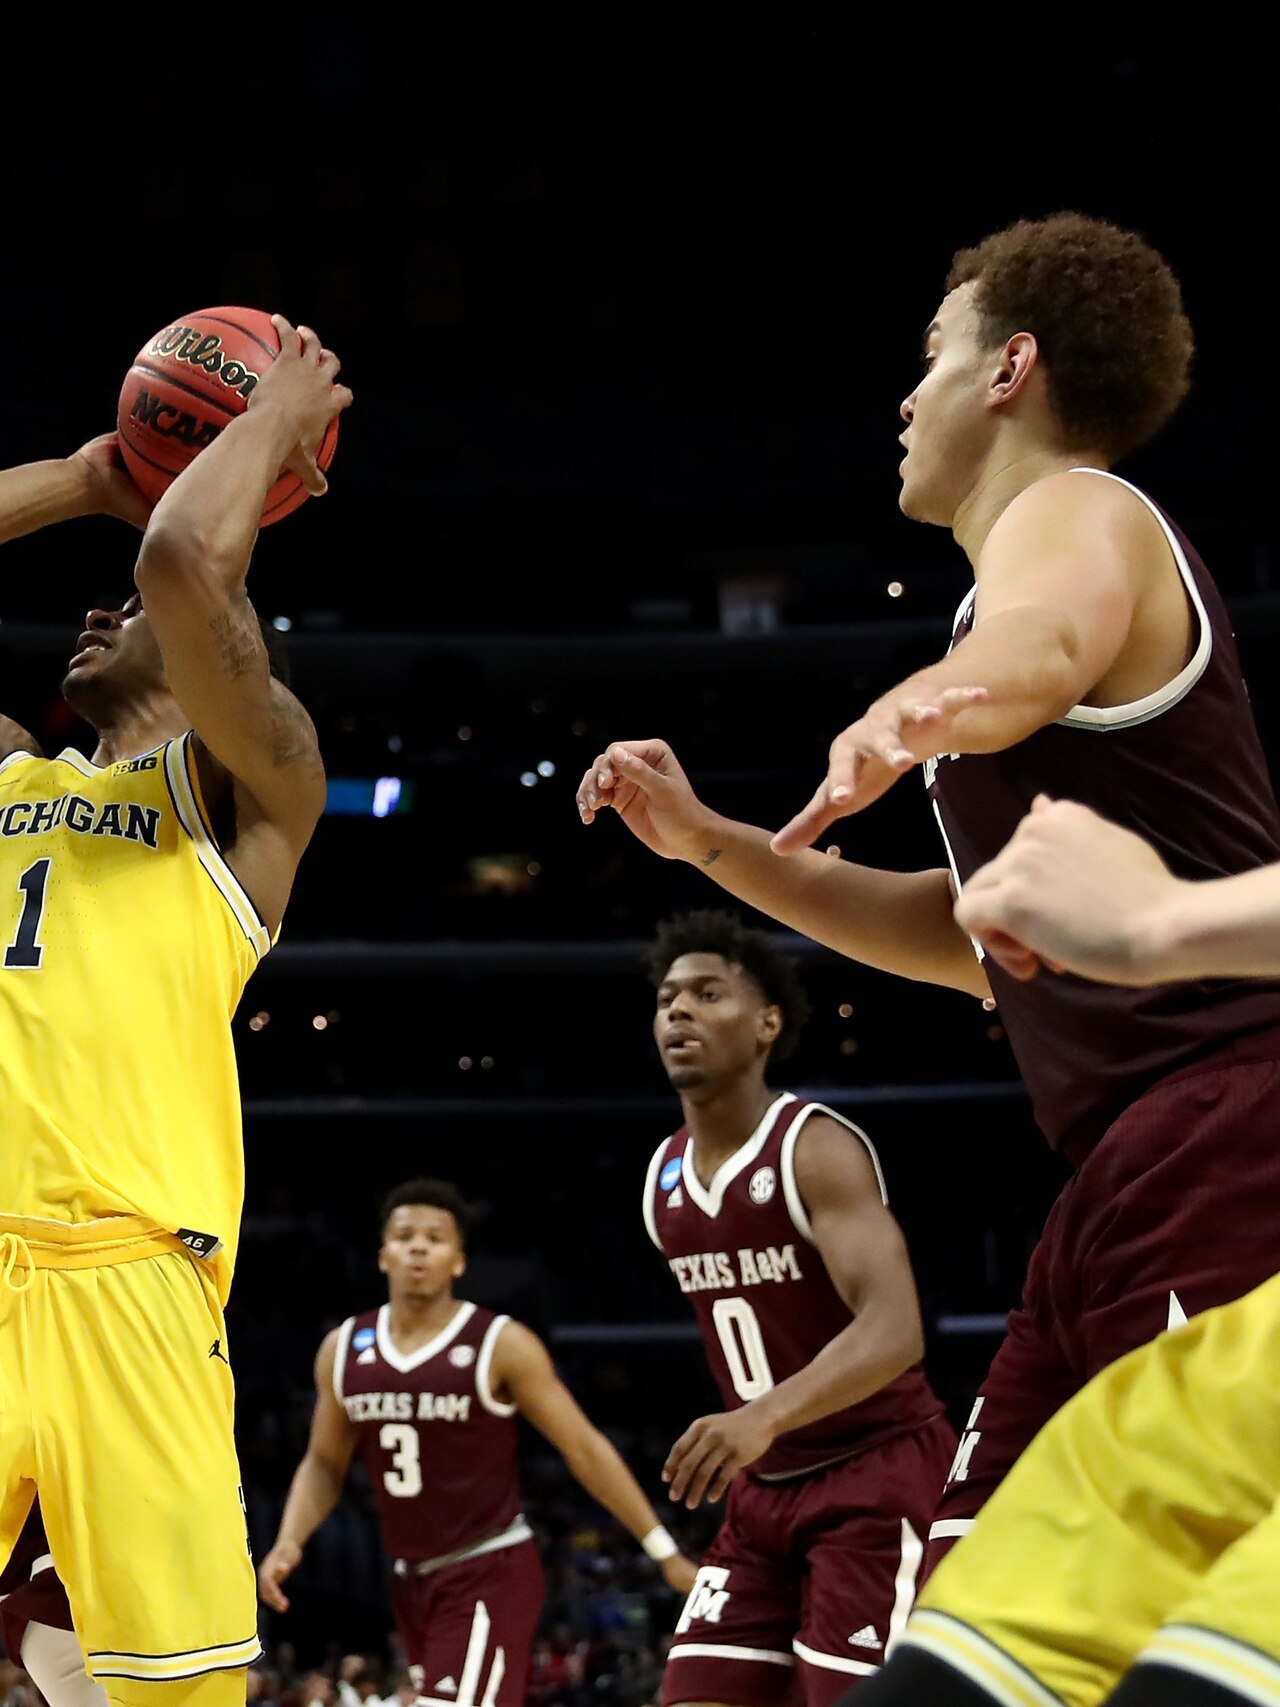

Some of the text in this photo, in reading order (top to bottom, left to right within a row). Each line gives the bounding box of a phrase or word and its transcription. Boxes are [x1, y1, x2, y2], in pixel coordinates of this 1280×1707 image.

[130, 387, 221, 449] NCAA
[1, 856, 54, 971] 1
[181, 1234, 205, 1249] 46
[668, 1244, 804, 1293] TEXAS A&M
[712, 1296, 774, 1402] 0
[342, 1391, 414, 1422] TEXAS
[379, 1422, 423, 1498] 3
